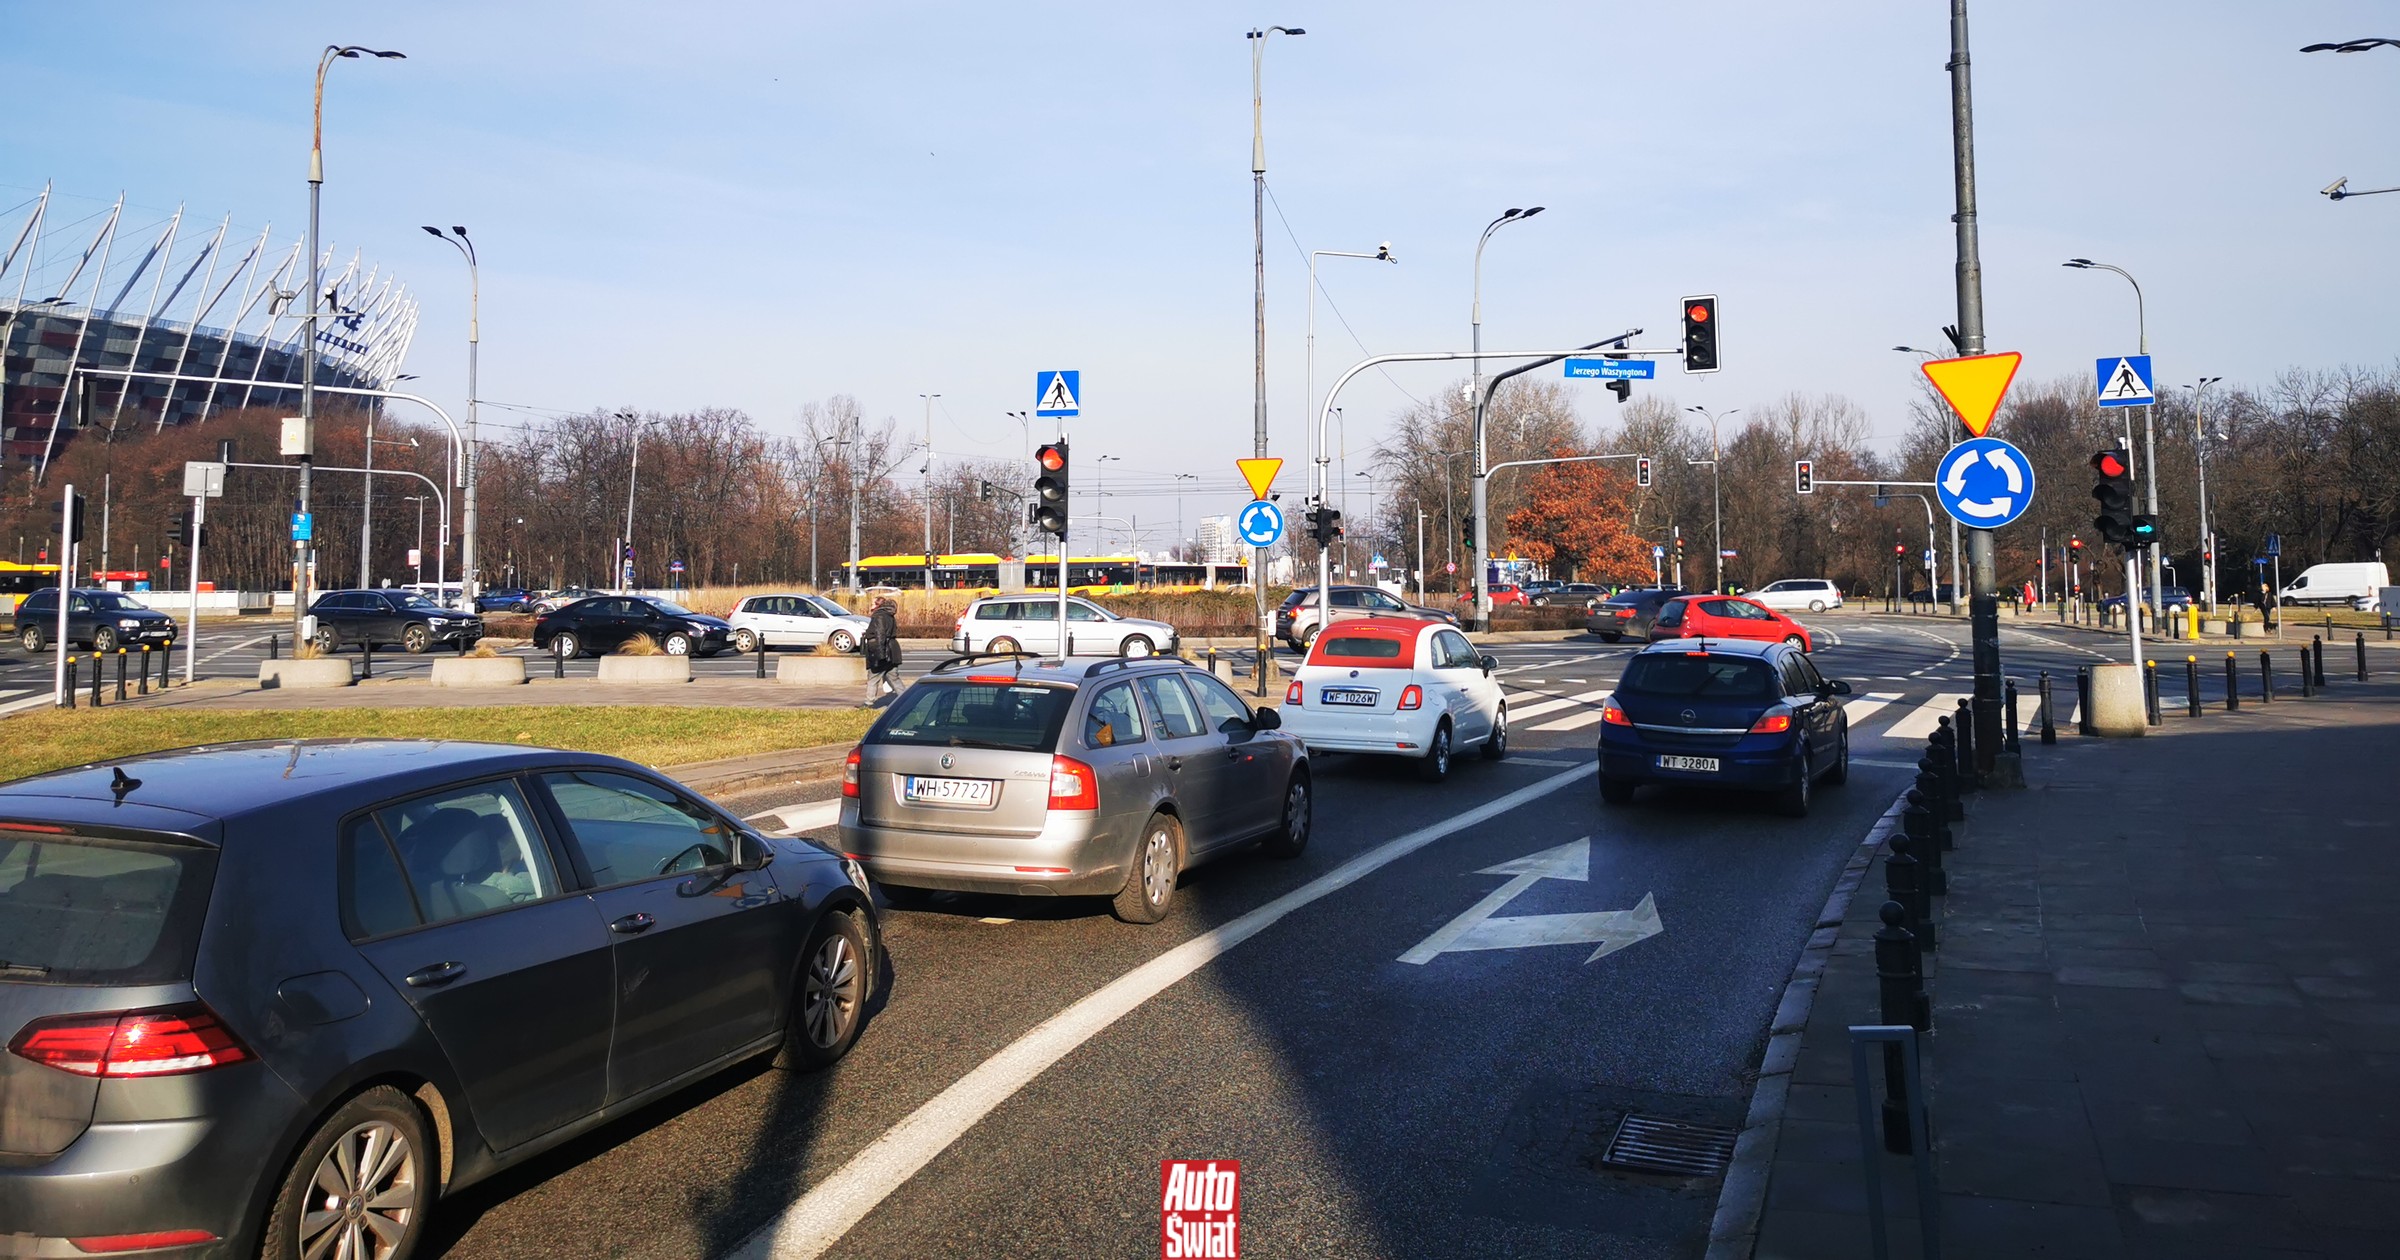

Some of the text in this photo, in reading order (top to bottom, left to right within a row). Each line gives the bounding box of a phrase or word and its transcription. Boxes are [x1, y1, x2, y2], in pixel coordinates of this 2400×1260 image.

[1573, 367, 1647, 378] Jerzego Waszyngtona
[1328, 692, 1374, 704] WF 1026W
[1663, 756, 1716, 770] WT 3280A
[916, 780, 989, 799] WH 57727
